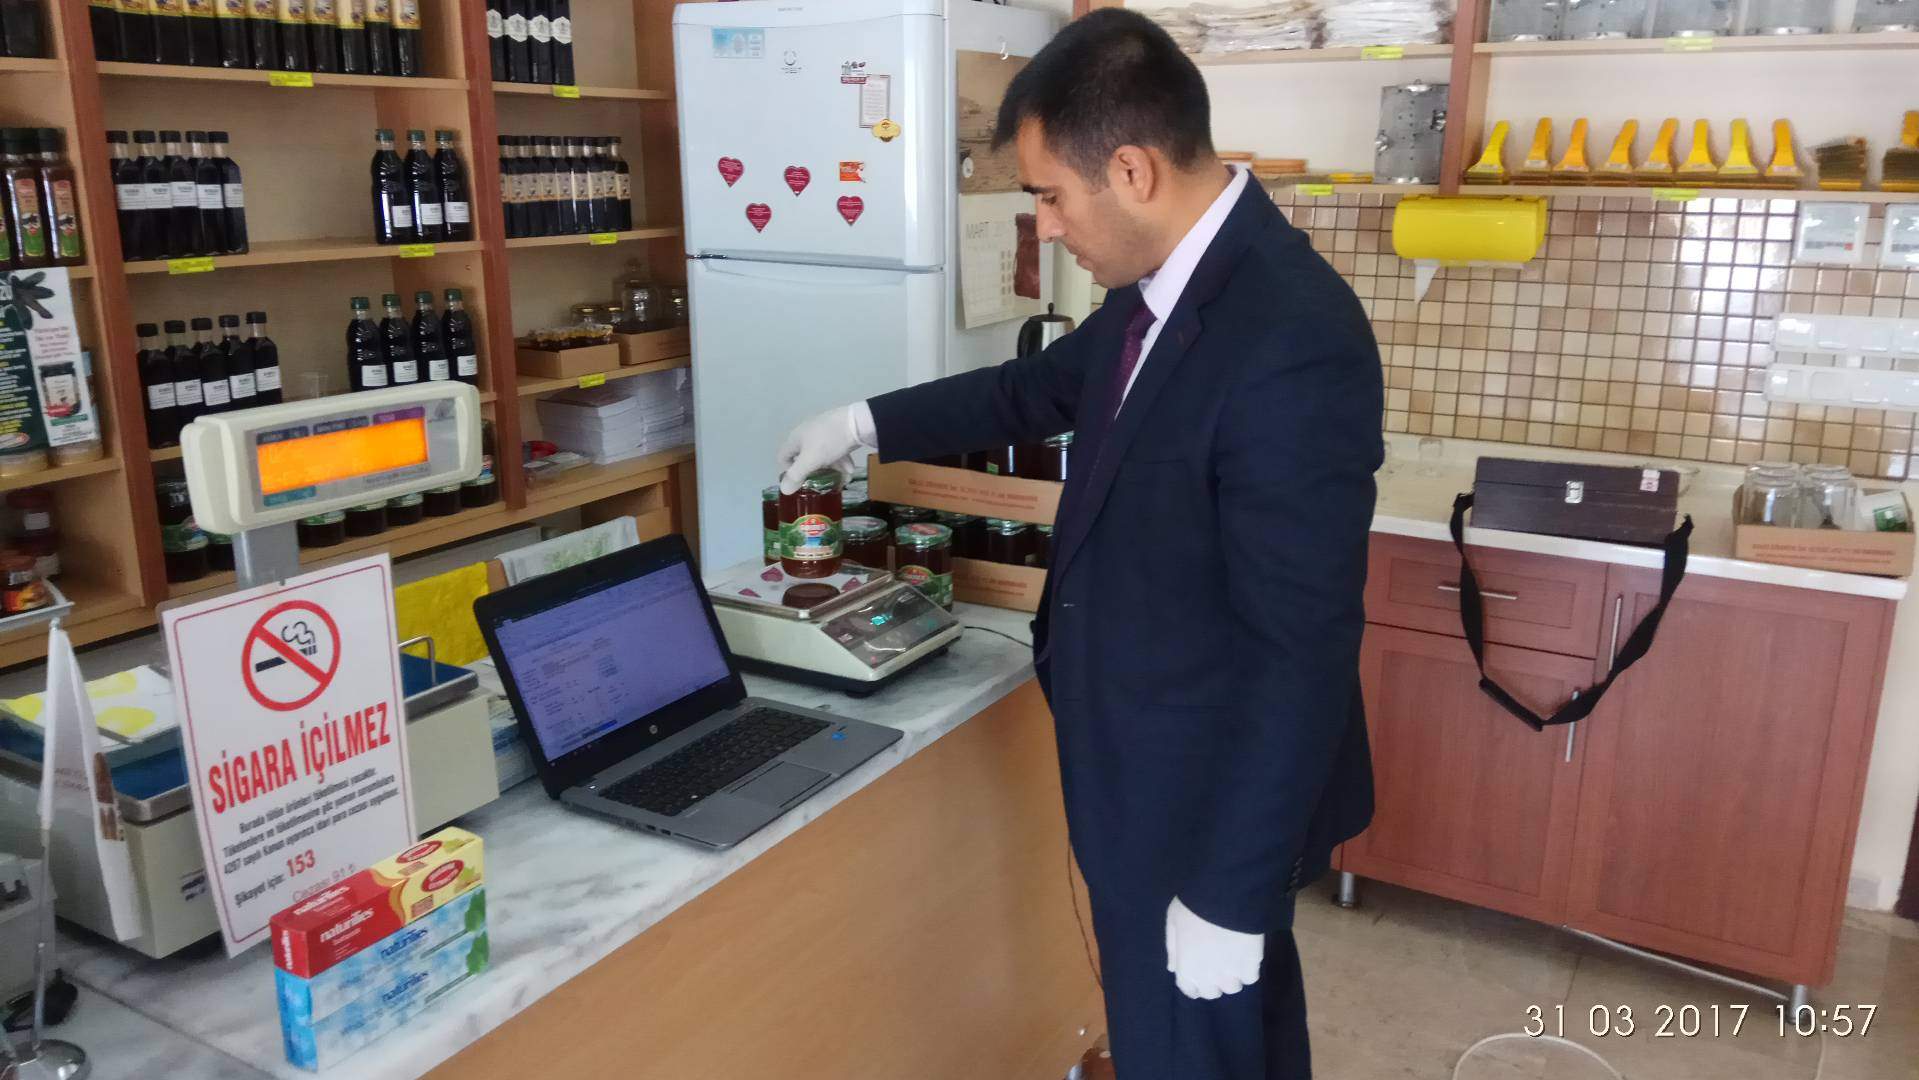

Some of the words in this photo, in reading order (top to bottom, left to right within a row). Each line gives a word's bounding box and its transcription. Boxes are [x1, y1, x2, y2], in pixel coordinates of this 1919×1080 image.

[208, 738, 298, 814] SİGARA
[300, 701, 391, 784] İÇİLMEZ
[239, 815, 266, 834] Burada
[266, 827, 275, 839] ve
[286, 849, 316, 877] 153
